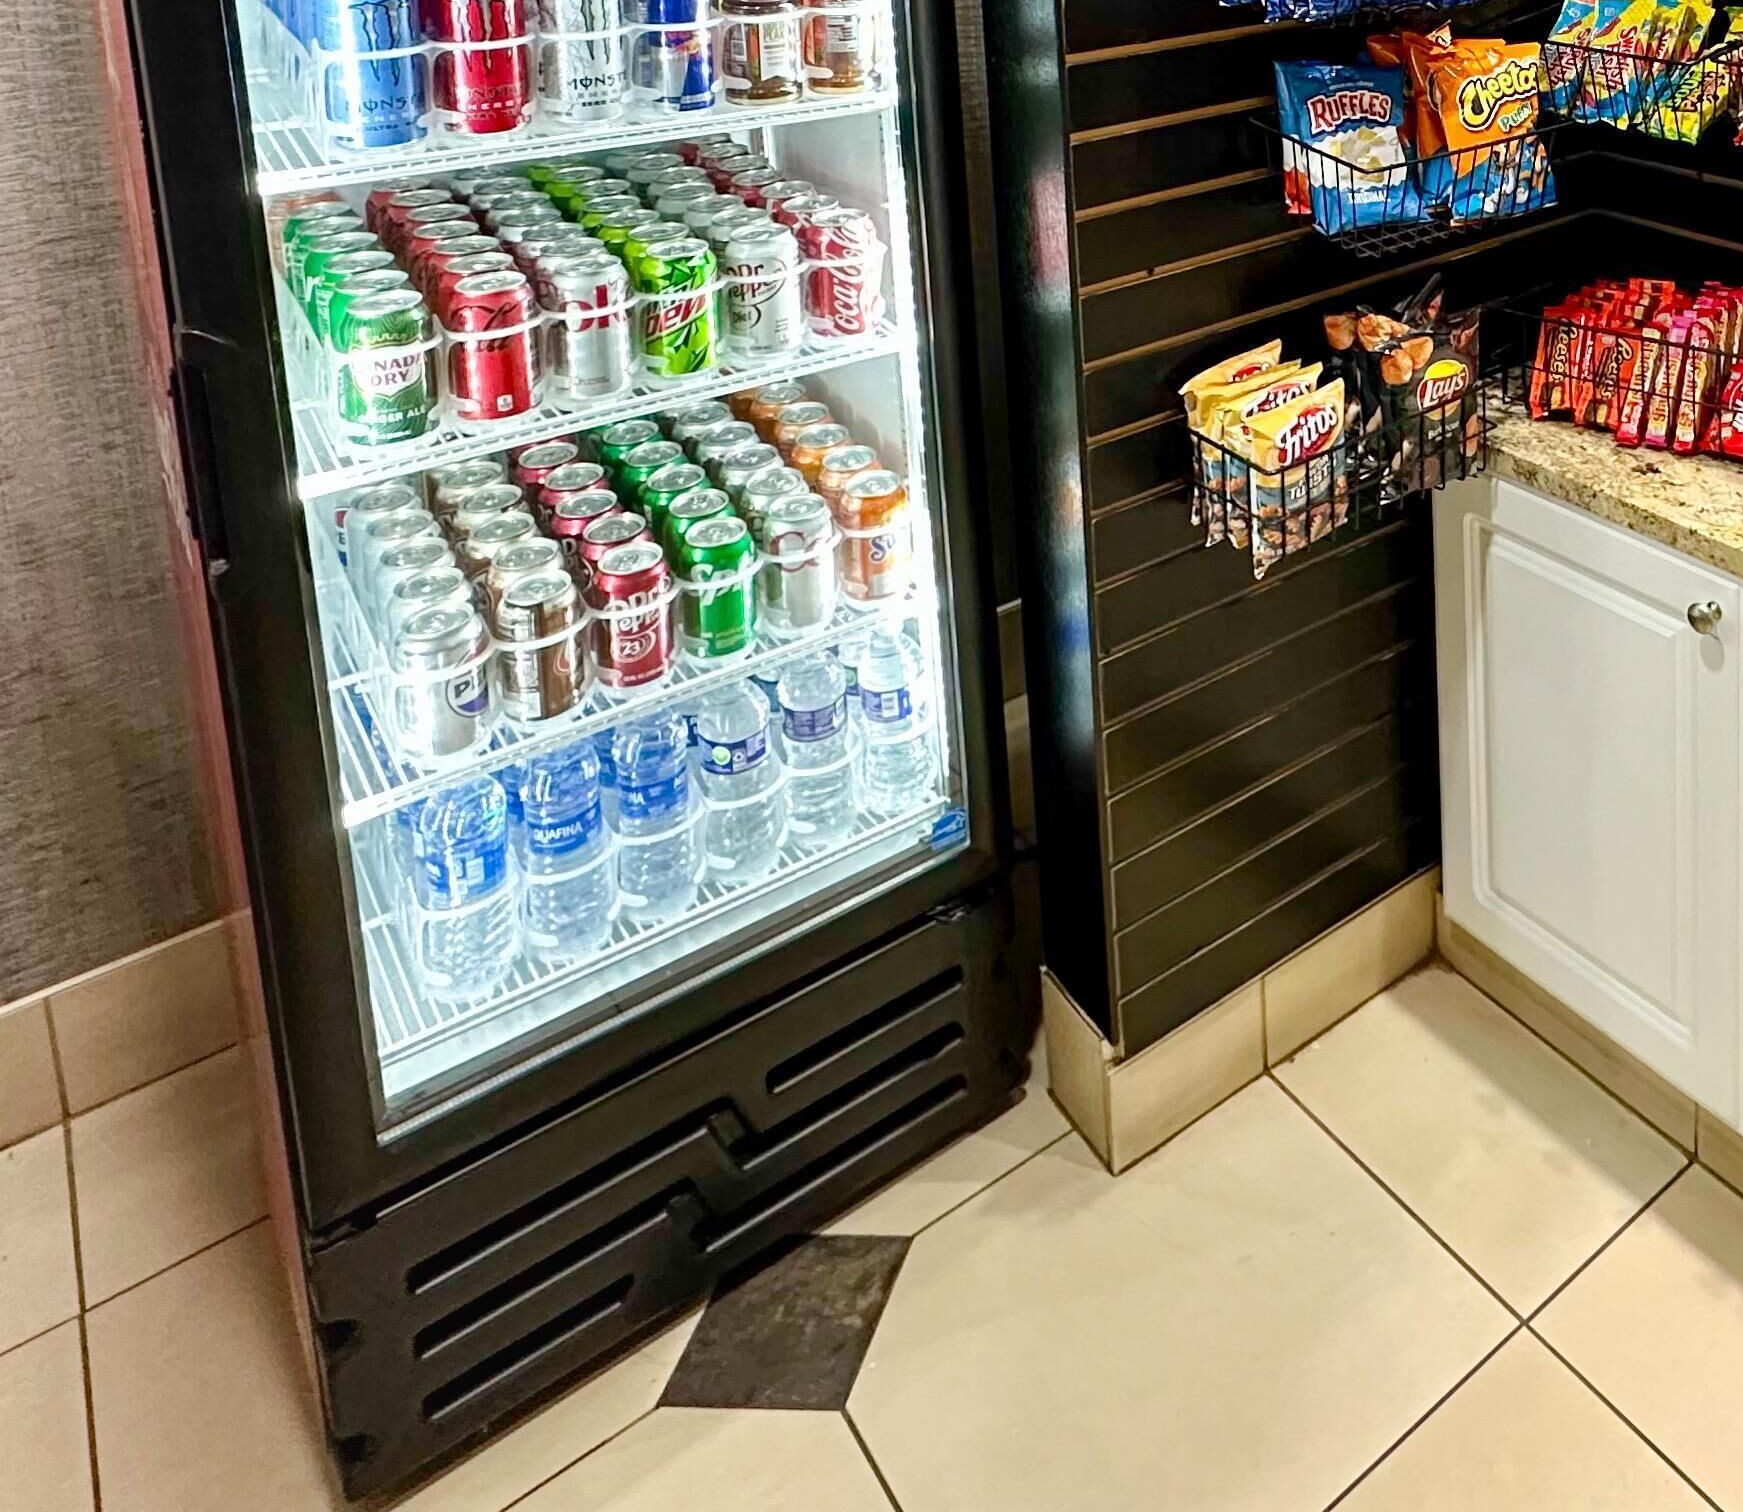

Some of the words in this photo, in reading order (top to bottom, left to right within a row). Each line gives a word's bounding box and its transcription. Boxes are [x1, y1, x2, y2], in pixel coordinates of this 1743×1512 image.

[1310, 91, 1391, 132] RUFFLES
[1459, 63, 1538, 128] Cheeto
[371, 371, 411, 387] DRY
[1275, 402, 1338, 467] Fritos
[621, 640, 641, 655] 23
